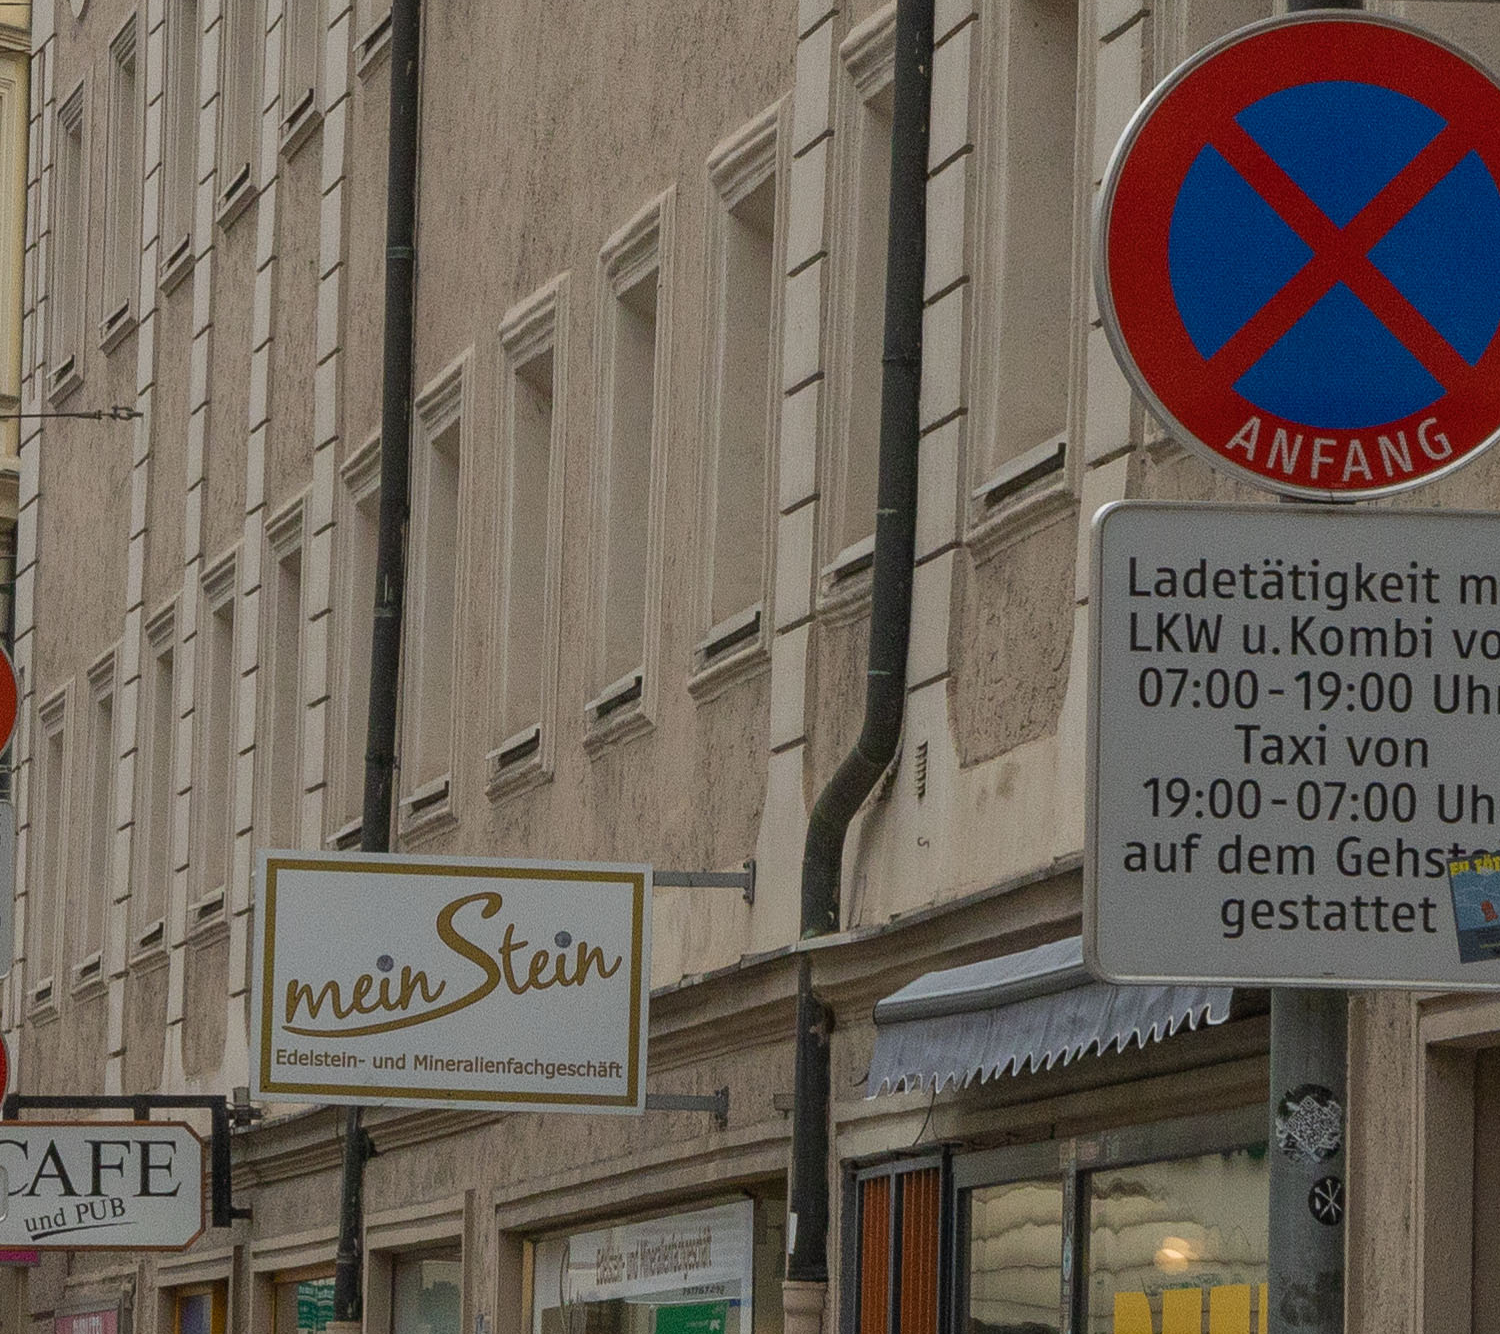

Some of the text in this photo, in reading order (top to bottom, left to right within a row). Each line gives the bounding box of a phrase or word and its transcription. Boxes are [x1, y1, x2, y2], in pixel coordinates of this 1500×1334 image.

[1226, 416, 1453, 482] ANFANG
[1129, 557, 1439, 611] Ladetätigkeit
[1130, 613, 1223, 653] LKW
[1235, 724, 1429, 768] Taxi von
[1123, 833, 1314, 876] auf dem
[1221, 895, 1437, 939] gestattet
[284, 955, 446, 1024] mein
[276, 1049, 623, 1080] Edelstein- und Mineralienfachgeschäft
[24, 1197, 127, 1234] und PUB
